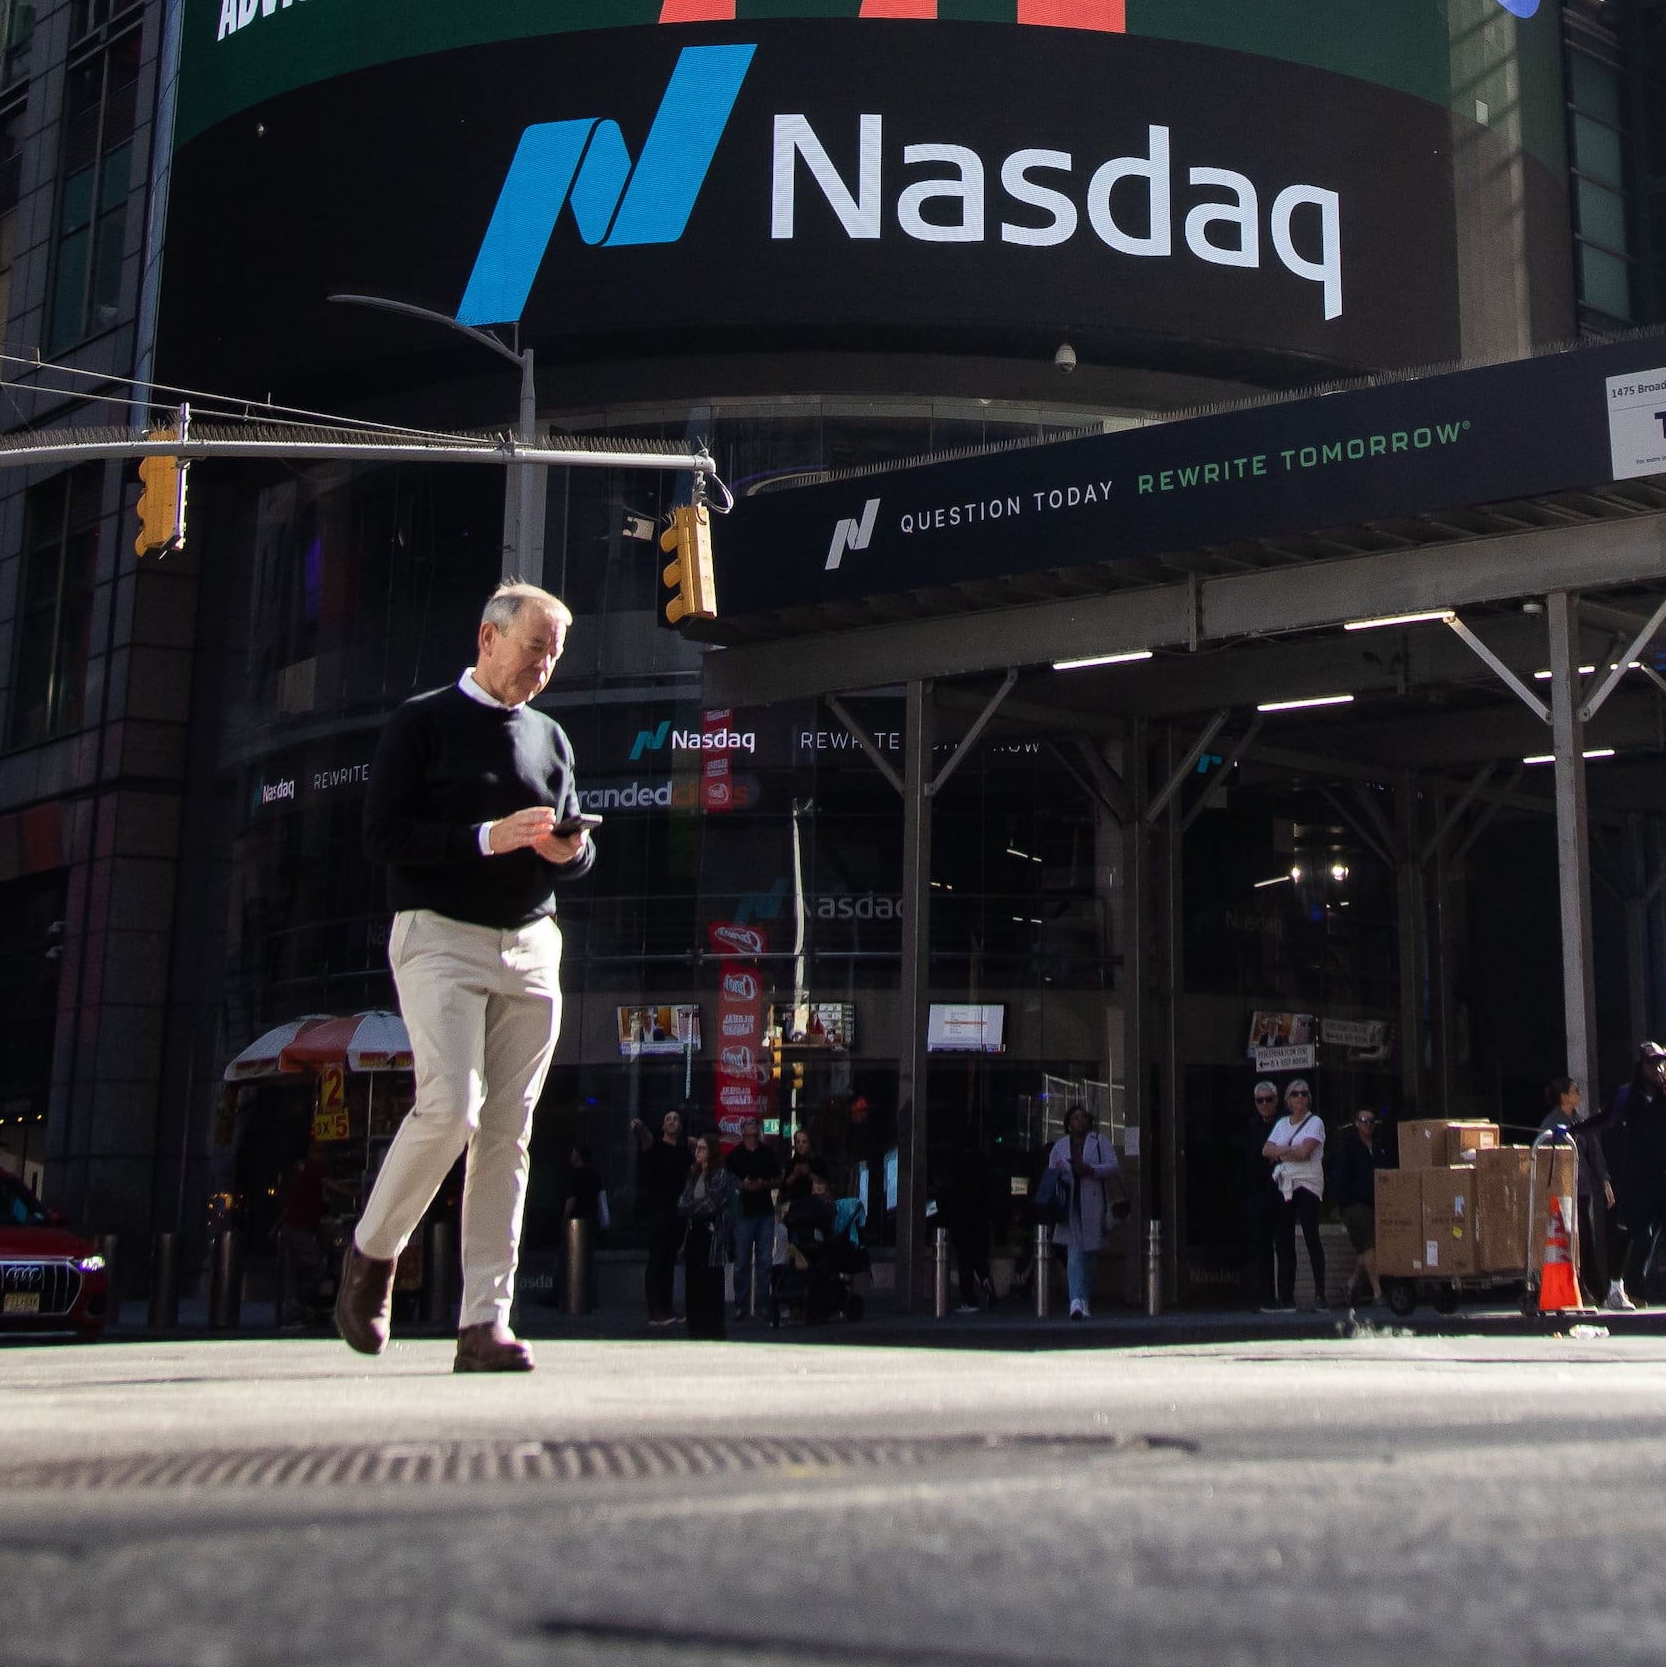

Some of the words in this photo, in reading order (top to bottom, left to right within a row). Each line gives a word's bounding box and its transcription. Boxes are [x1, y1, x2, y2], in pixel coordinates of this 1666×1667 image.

[771, 113, 1343, 321] Nasdaq
[1611, 385, 1635, 399] 1475
[900, 496, 1021, 533] QUESTION
[1032, 480, 1114, 512] TODAY
[1138, 454, 1267, 495] REWRITE
[672, 728, 756, 753] Nasdaq
[262, 778, 295, 804] Nasdaq
[313, 763, 370, 790] REWRITE
